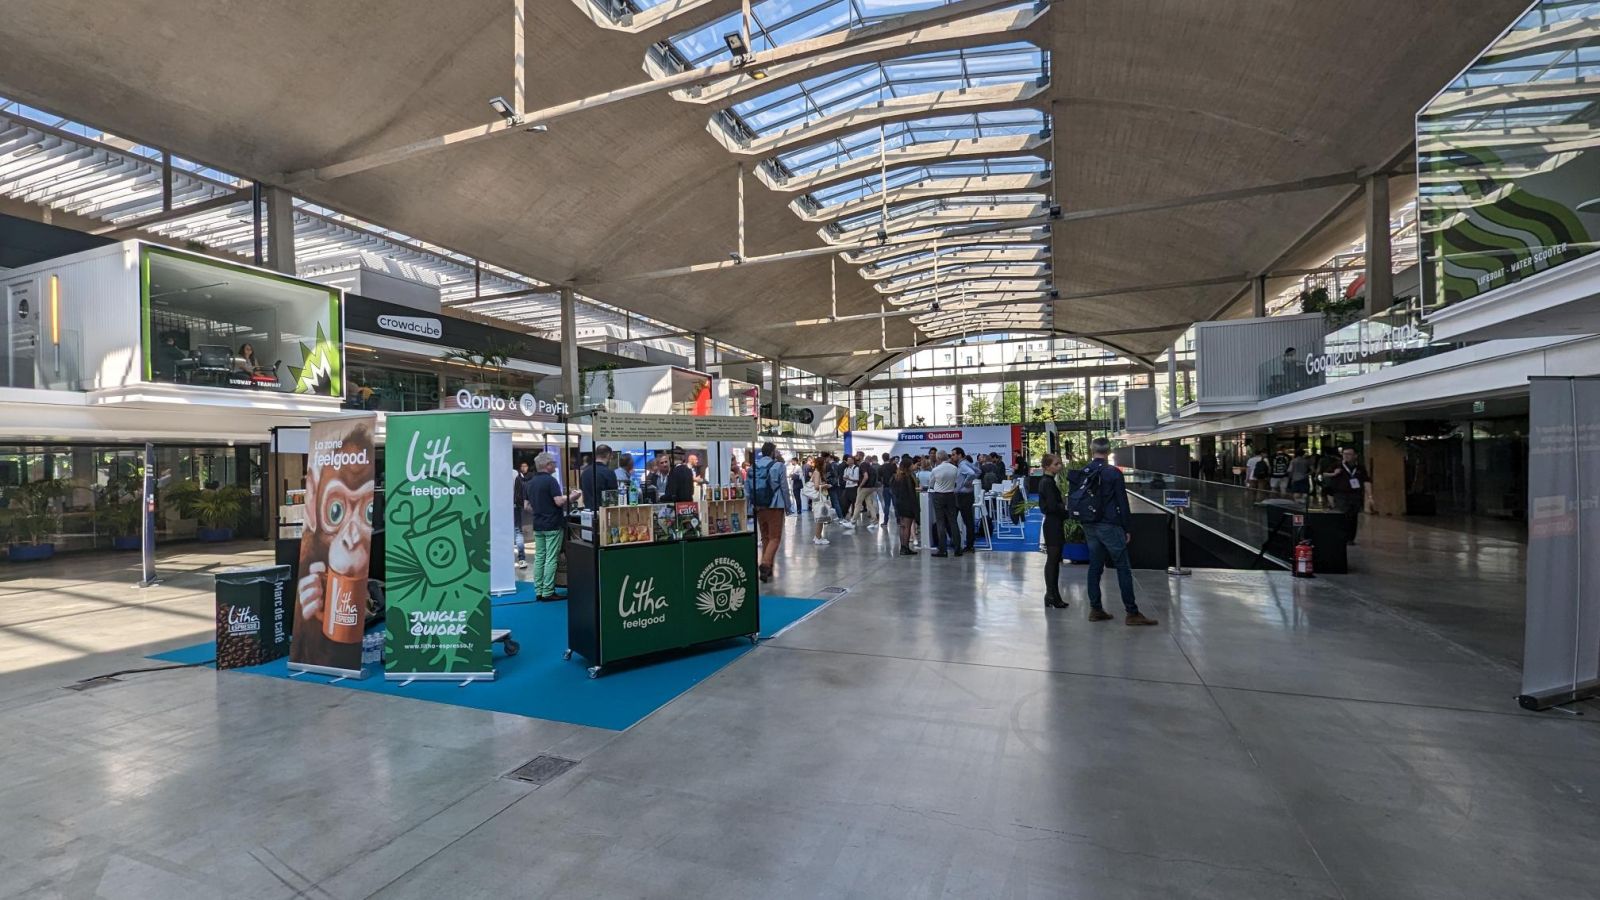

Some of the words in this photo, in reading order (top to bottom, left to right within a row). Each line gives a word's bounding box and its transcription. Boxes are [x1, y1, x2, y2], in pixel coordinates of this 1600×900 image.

[1477, 268, 1505, 285] LIFEBOAT
[1510, 257, 1533, 273] WATER
[1533, 242, 1567, 263] SCOOTER
[379, 317, 440, 336] crowdcube
[1305, 353, 1341, 376] Google
[456, 388, 505, 411] Qonto
[508, 396, 517, 410] &
[539, 400, 569, 415] PayFit
[314, 440, 324, 450] La
[325, 439, 343, 449] zone
[928, 432, 960, 440] Quantum
[314, 448, 370, 471] feelgood.
[406, 430, 471, 483] Litha
[411, 484, 466, 499] feelgood
[714, 557, 746, 579] FEELGOOD
[274, 582, 284, 607] Marc
[619, 574, 669, 618] Litha
[228, 604, 260, 625] Litha
[275, 608, 285, 621] de
[410, 610, 467, 622] JUNGLE
[623, 613, 666, 629] feelgood
[275, 621, 285, 643] café
[410, 622, 468, 636] @WORK
